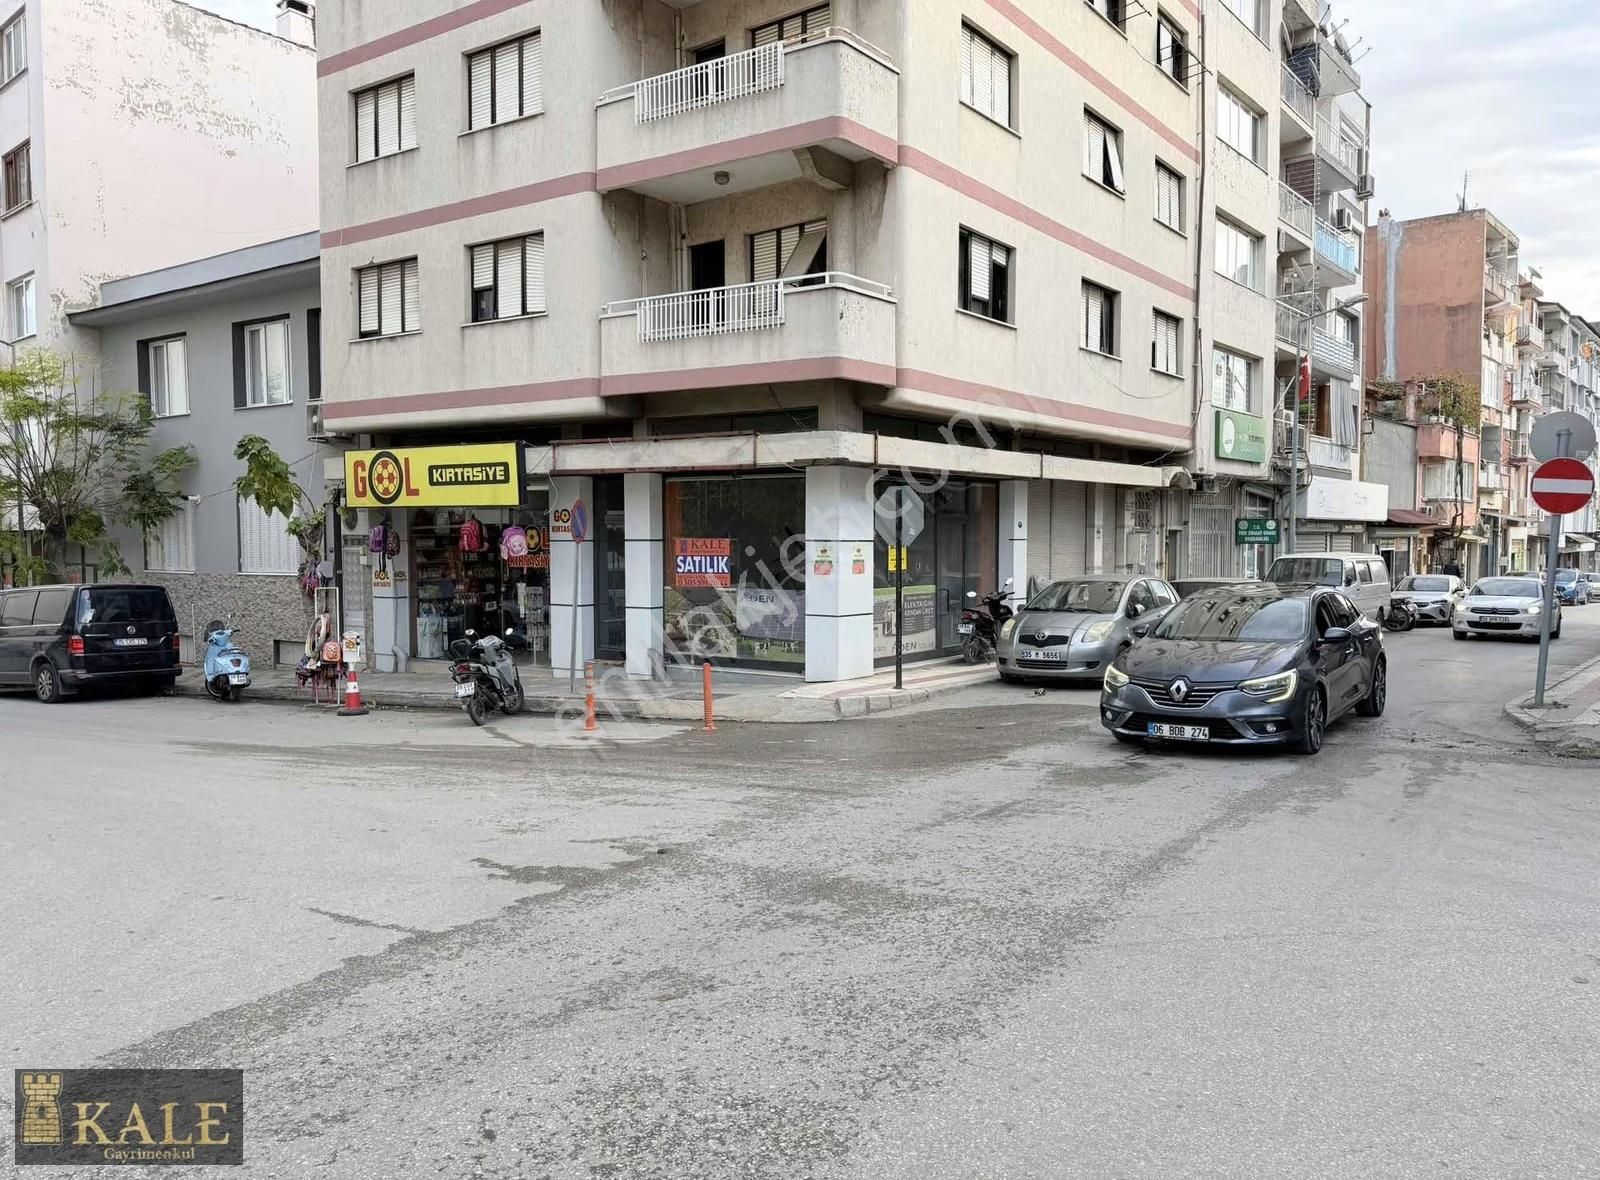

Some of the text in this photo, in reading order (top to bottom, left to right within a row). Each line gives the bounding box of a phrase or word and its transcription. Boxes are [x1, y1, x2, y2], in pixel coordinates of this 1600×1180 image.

[353, 450, 420, 505] GOL
[553, 508, 571, 523] GO
[691, 539, 726, 549] KALE
[676, 555, 729, 573] SATILIK
[1153, 724, 1208, 739] 06 BDB 274
